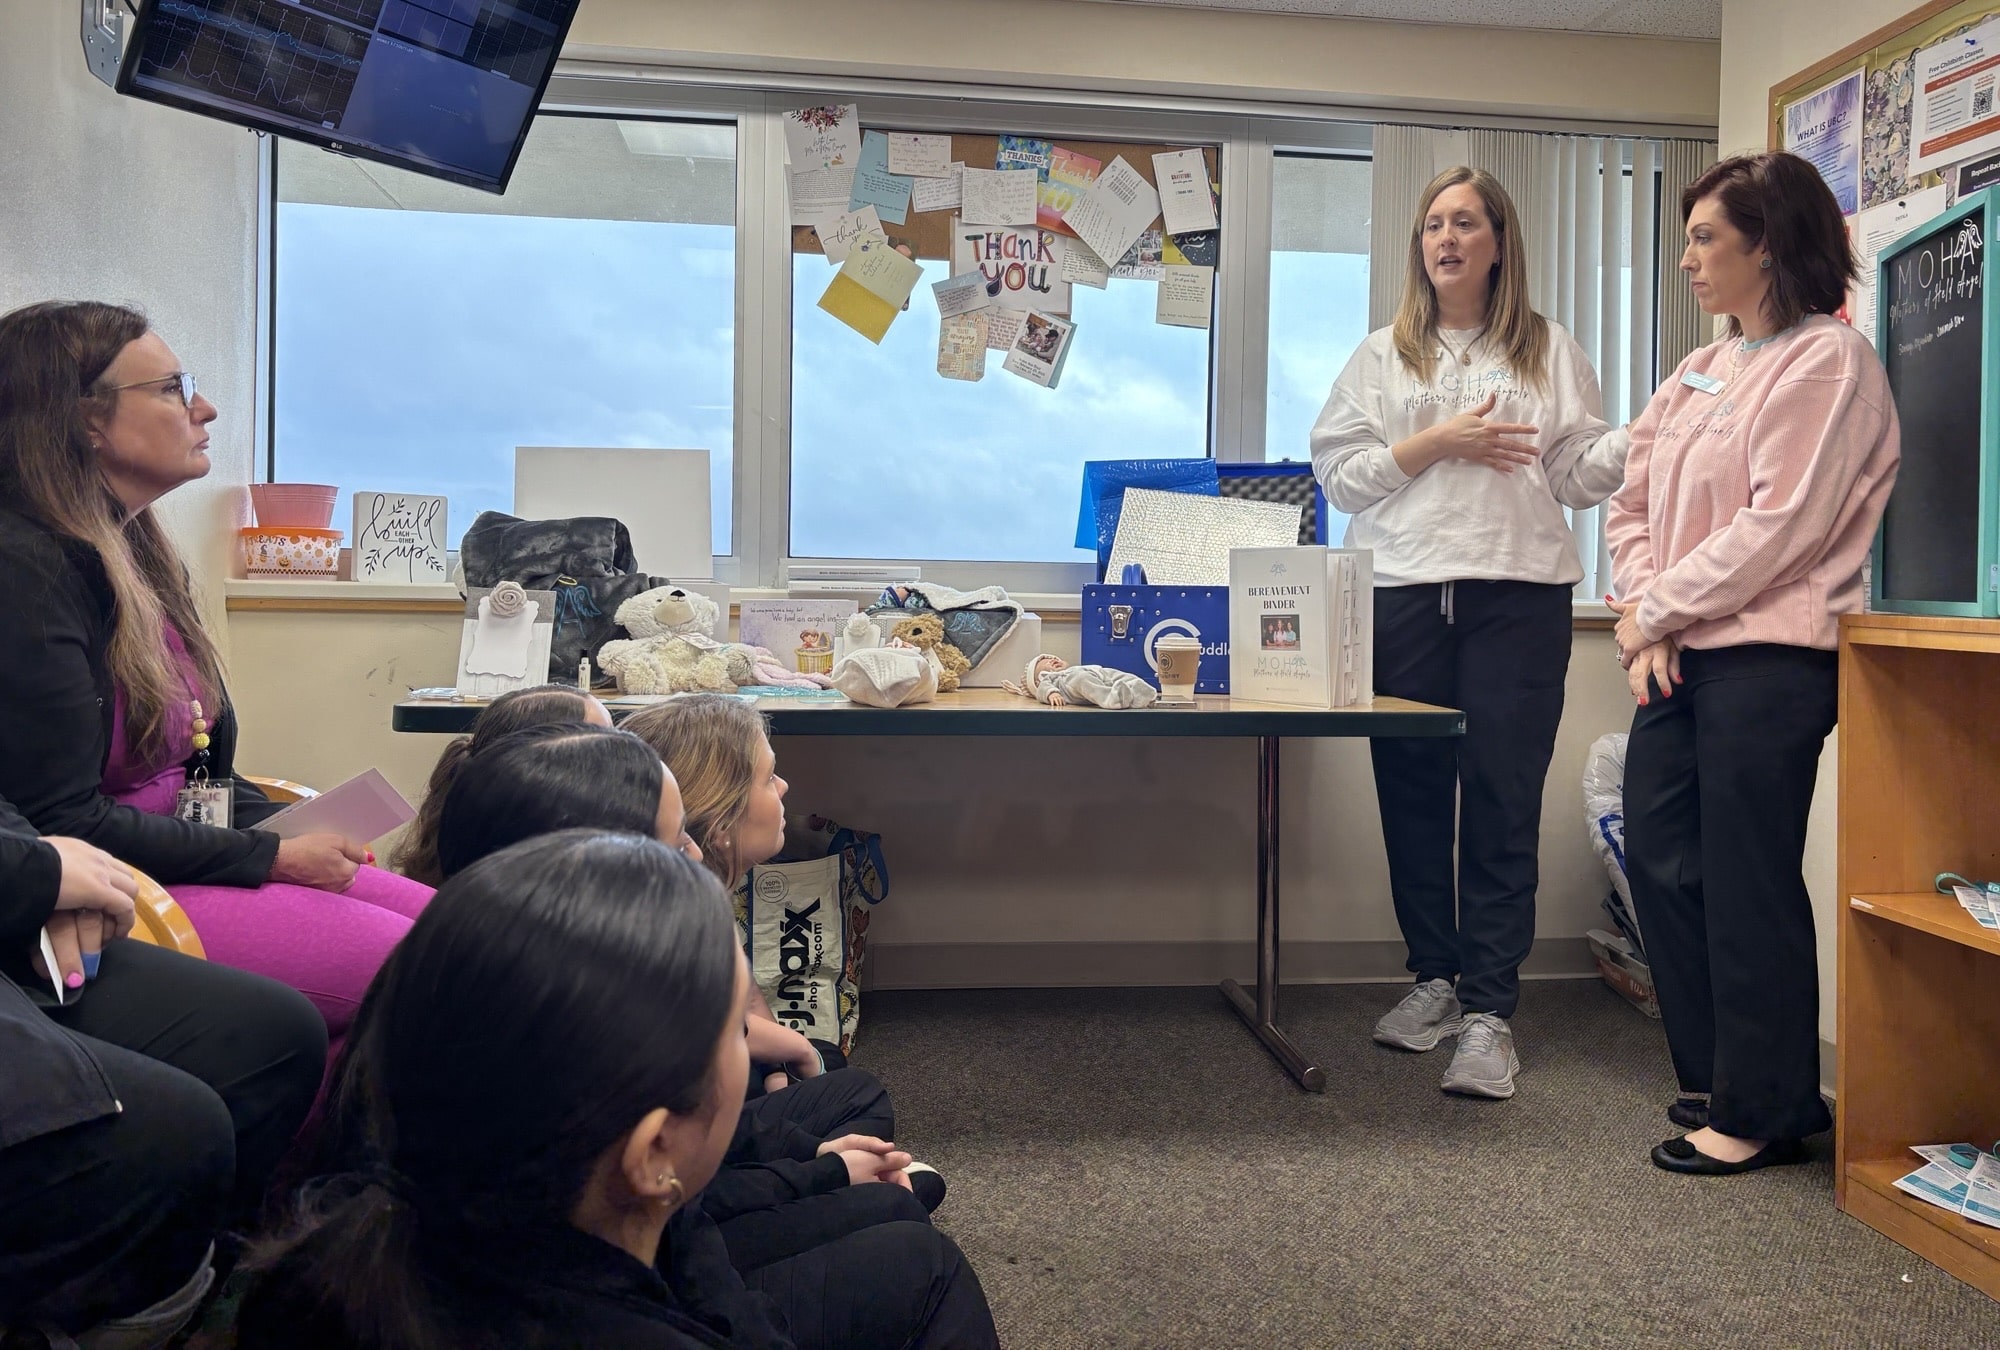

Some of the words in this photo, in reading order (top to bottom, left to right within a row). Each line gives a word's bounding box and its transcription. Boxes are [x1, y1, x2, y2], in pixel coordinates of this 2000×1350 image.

[1928, 65, 1940, 73] Free
[1940, 55, 1964, 69] Childbirth
[1965, 47, 1984, 59] Classes
[1797, 124, 1818, 141] WHAT
[1820, 121, 1826, 133] IS
[1827, 111, 1847, 128] UBC?
[1006, 151, 1043, 164] THANKS
[1051, 155, 1093, 184] Thank
[1971, 165, 1989, 178] Repeat
[1932, 277, 1954, 310] Held
[1403, 391, 1447, 413] Mothers
[1451, 396, 1459, 409] of
[1460, 388, 1486, 408] Held
[1495, 384, 1529, 400] Angels
[360, 493, 441, 550] build
[382, 544, 429, 583] up
[1248, 585, 1311, 596] BEREAVEMENT
[1263, 600, 1295, 609] BINDER
[772, 613, 783, 622] We
[784, 613, 796, 623] had
[807, 613, 826, 627] angel
[807, 981, 821, 1010] shop
